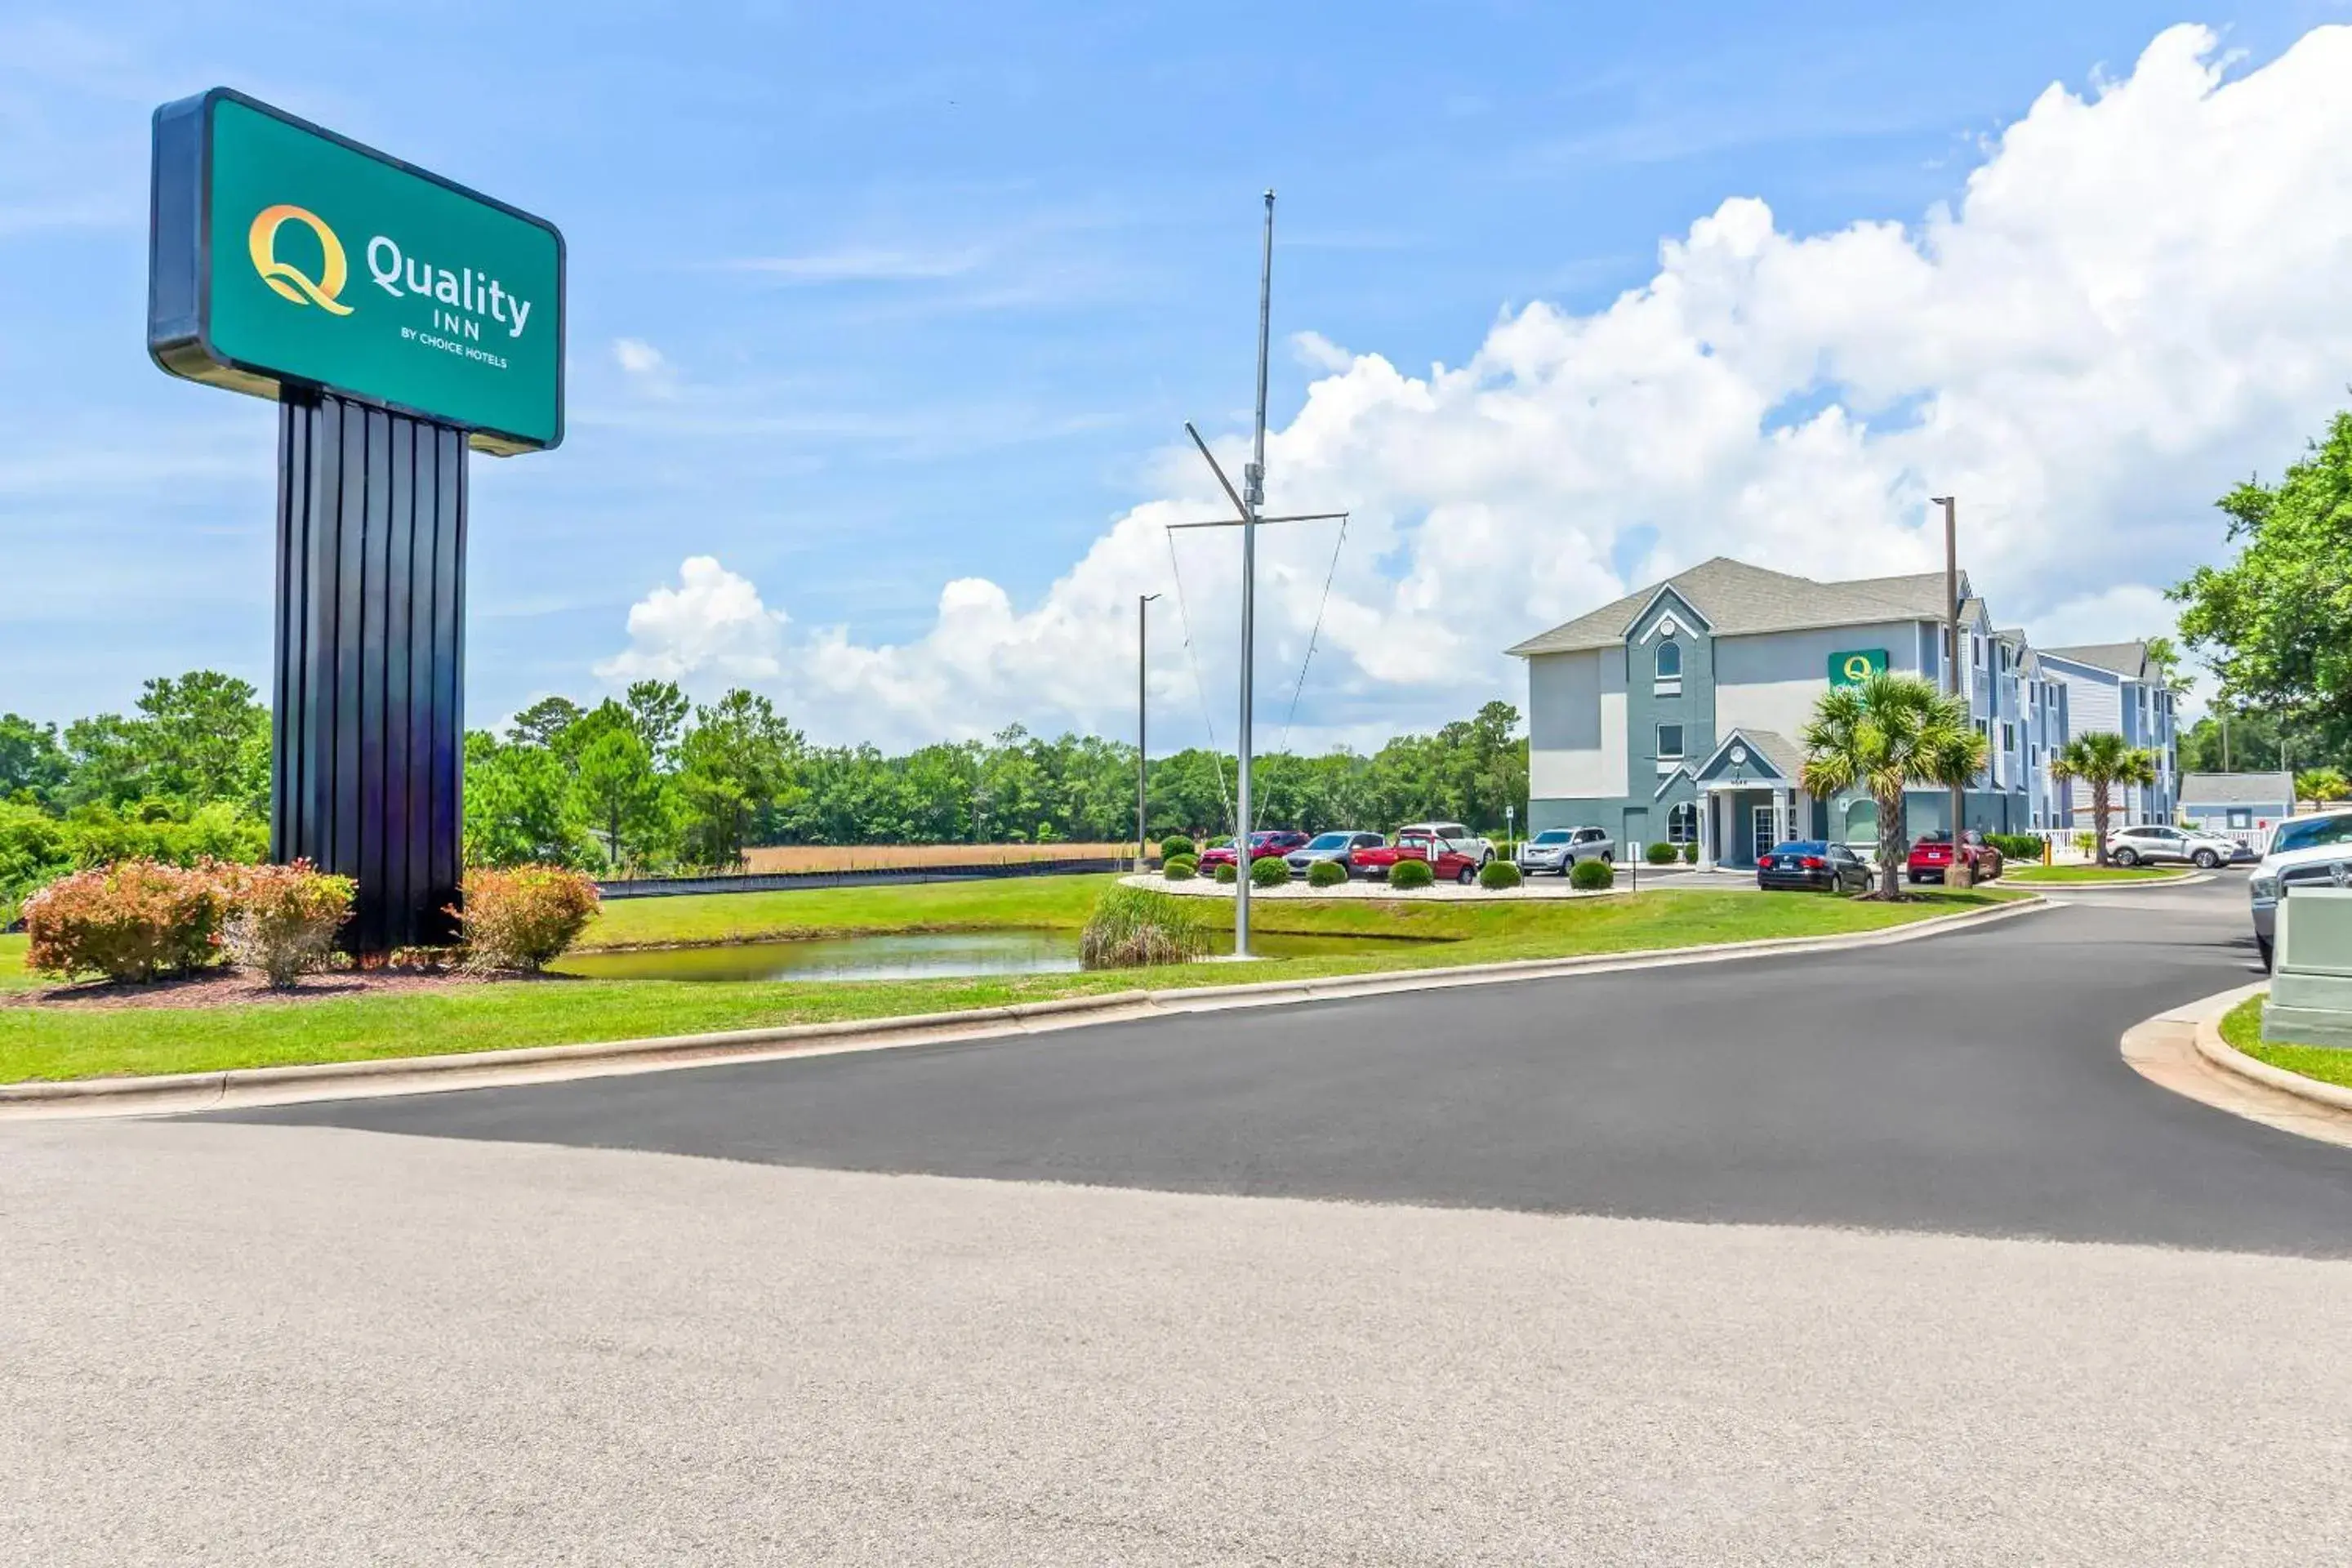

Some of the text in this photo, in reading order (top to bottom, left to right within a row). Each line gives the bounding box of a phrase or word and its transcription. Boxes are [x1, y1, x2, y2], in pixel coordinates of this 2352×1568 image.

[248, 204, 355, 316] Q
[368, 235, 531, 337] Quality
[434, 308, 479, 342] INN
[400, 327, 508, 369] BY CHOICE HOTELS
[1843, 656, 1873, 680] Q
